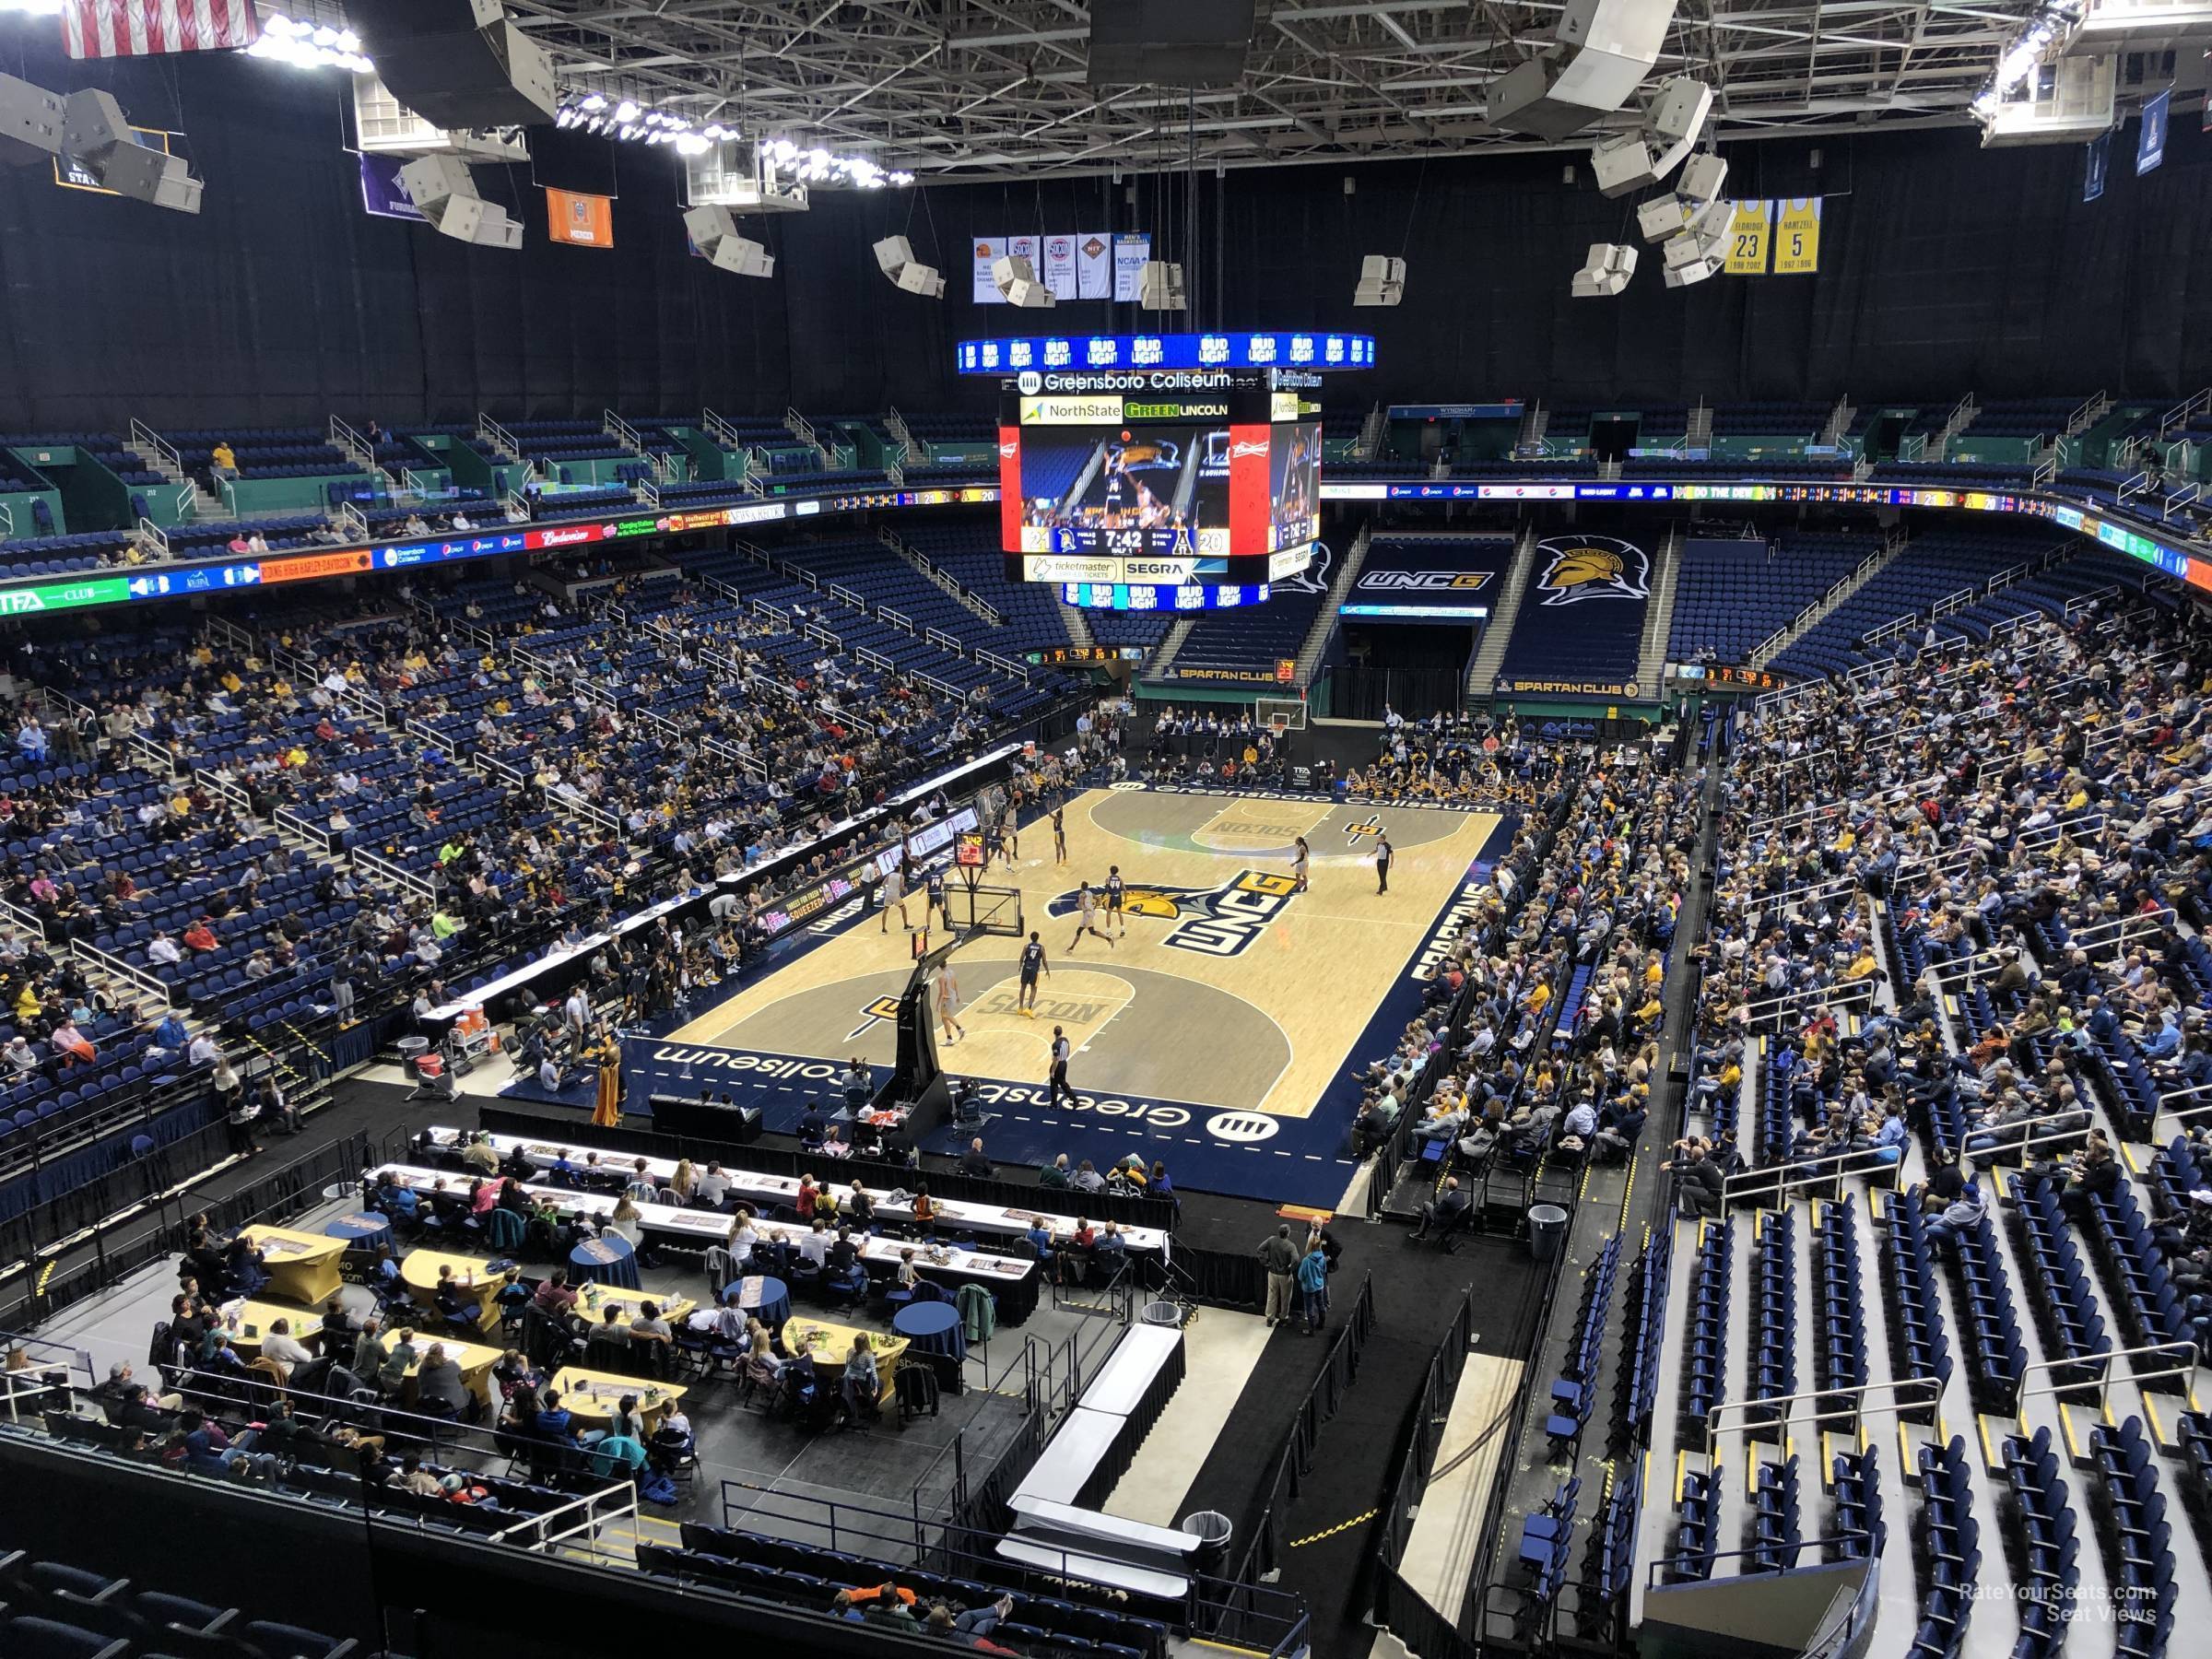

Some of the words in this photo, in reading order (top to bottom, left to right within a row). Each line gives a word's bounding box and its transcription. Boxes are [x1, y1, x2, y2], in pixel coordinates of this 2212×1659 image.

[1736, 235, 1759, 257] 23
[1793, 233, 1802, 256] 5
[1011, 343, 1030, 355] BUD
[1046, 341, 1069, 354] BUD
[1089, 340, 1115, 353] BUD
[1133, 339, 1161, 352] BUD
[1201, 337, 1228, 351] BUD
[1251, 337, 1276, 350] BUD
[1292, 338, 1312, 349] BUD
[1009, 354, 1032, 367] LIGHT
[1044, 353, 1071, 366] LIGHT
[1088, 352, 1117, 365] LIGHT
[1132, 351, 1163, 364] LIGHT
[1198, 350, 1230, 362] LIGHT
[1249, 349, 1277, 362] LIGHT
[1290, 349, 1314, 361] LIGHT
[1044, 373, 1145, 390] Greensboro
[1150, 372, 1230, 388] Coliseum
[1050, 404, 1121, 417] NorthState
[1124, 402, 1179, 418] GREEN
[1180, 405, 1228, 417] LINCOLN
[924, 494, 935, 504] 21
[982, 492, 994, 502] 20
[1696, 487, 1707, 498] DO
[1711, 487, 1729, 498] THE
[1847, 490, 1855, 499] 14
[1924, 493, 1936, 505] 21
[1985, 499, 1996, 510] 20
[542, 531, 588, 547] Budweiser
[1030, 533, 1051, 549] 21
[1106, 531, 1142, 547] 7:42
[1199, 534, 1222, 551] 20
[1055, 560, 1112, 571] ticketmaster
[1127, 563, 1182, 574] SEGRA
[1361, 572, 1488, 589] UNCG
[65, 588, 95, 601] CLUB
[1091, 583, 1112, 596] BUD
[1129, 585, 1156, 597] BUD
[1177, 585, 1203, 598] BUD
[1218, 585, 1240, 595] BUD
[1090, 595, 1114, 607] LIGHT
[1128, 597, 1158, 608] LIGHT
[1175, 597, 1204, 608] LIGHT
[1217, 594, 1241, 606] LIGHT
[1181, 669, 1238, 680] SPARTAN
[1240, 672, 1274, 681] CLUB
[1279, 668, 1292, 678] 23
[1514, 681, 1582, 692] SPARTAN
[1583, 684, 1622, 695] CLUB
[1155, 785, 1332, 803] Greensboro
[1345, 797, 1496, 813] Coliseum
[1215, 821, 1302, 837] SOCON
[931, 878, 941, 887] 14
[1110, 880, 1121, 889] 44
[789, 898, 823, 922] SQUEEZED
[1169, 870, 1304, 955] UNCG
